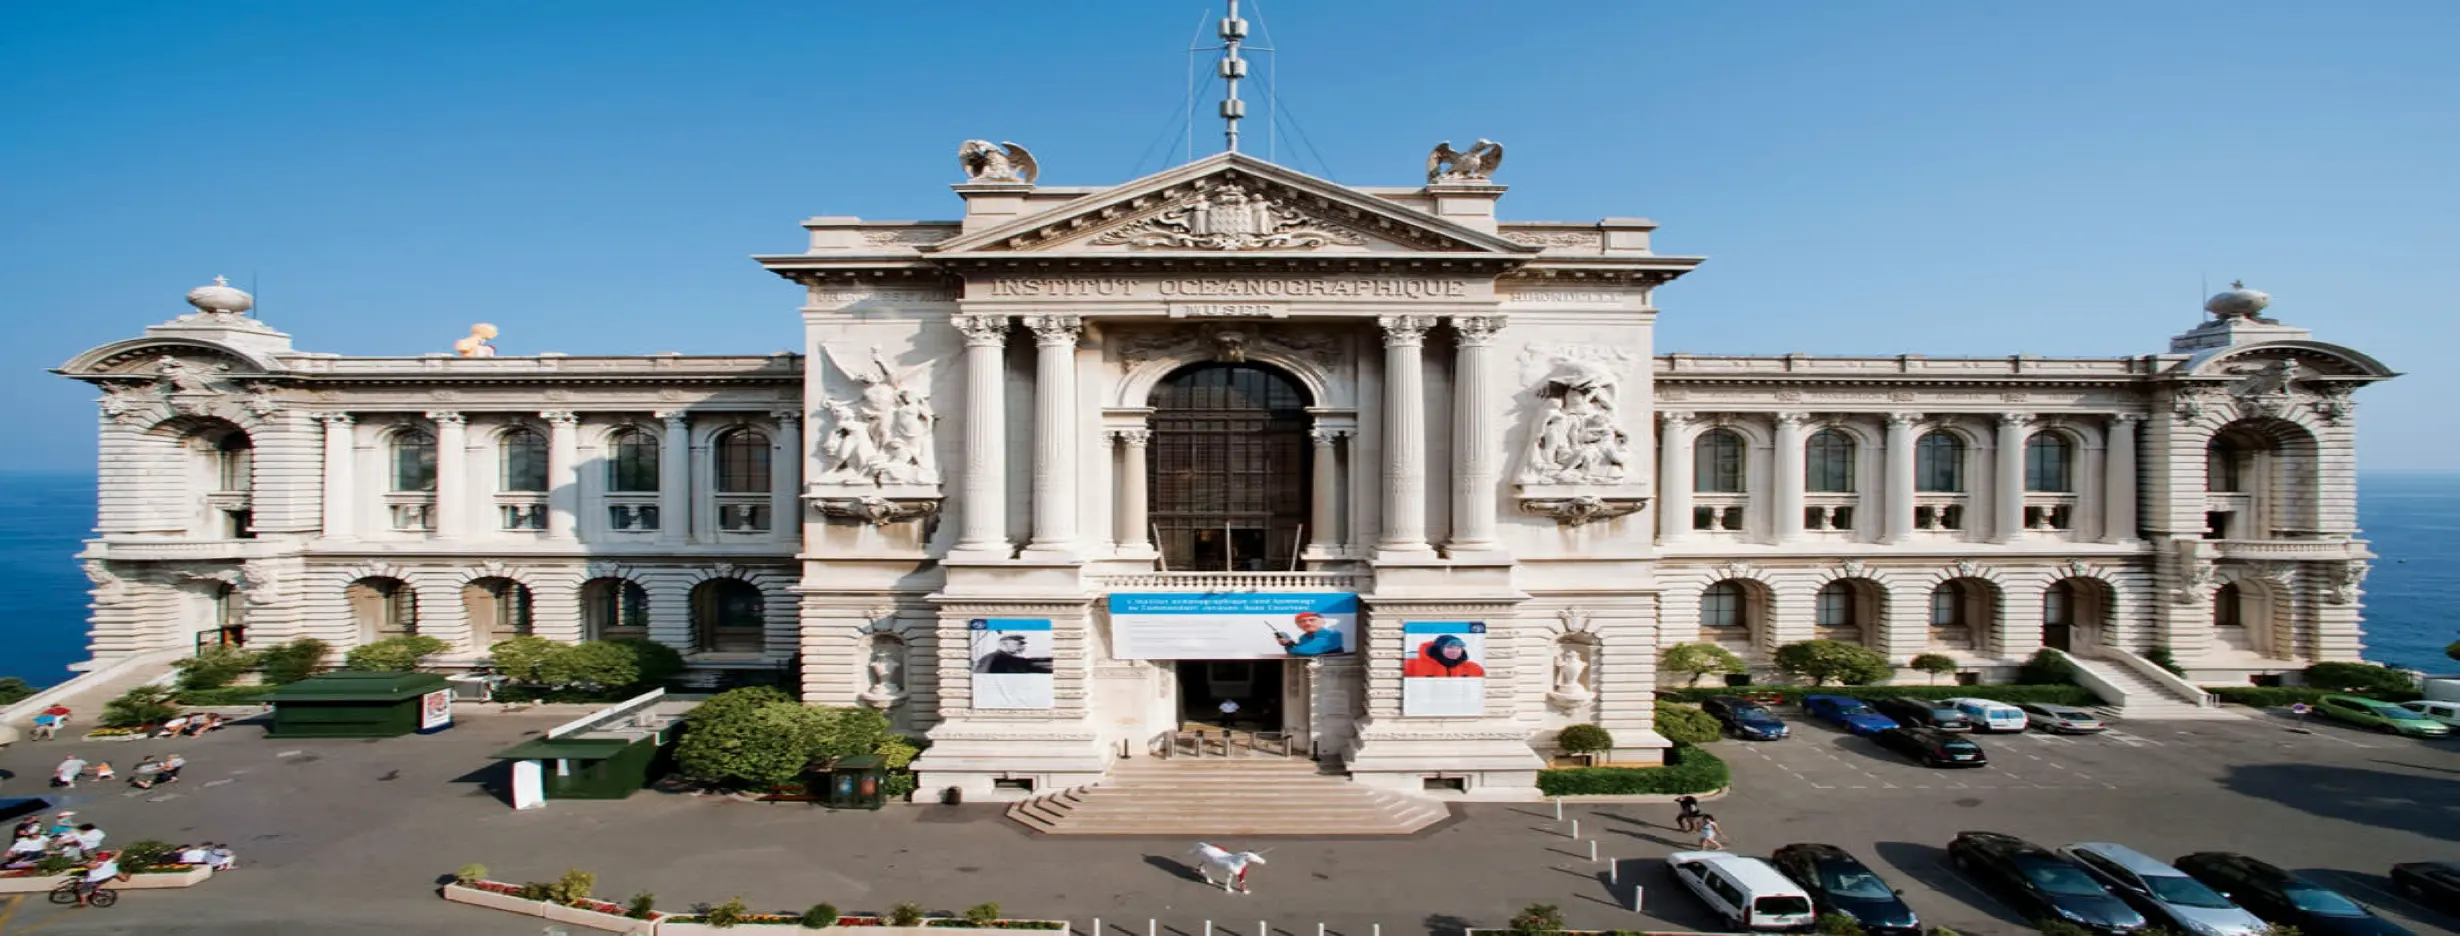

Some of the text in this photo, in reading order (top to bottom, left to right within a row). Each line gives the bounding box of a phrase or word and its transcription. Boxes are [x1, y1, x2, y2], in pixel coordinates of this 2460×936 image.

[990, 278, 1468, 299] INSTITUT OCEANOGRAPHIQUE
[1185, 303, 1271, 316] MUSEE
